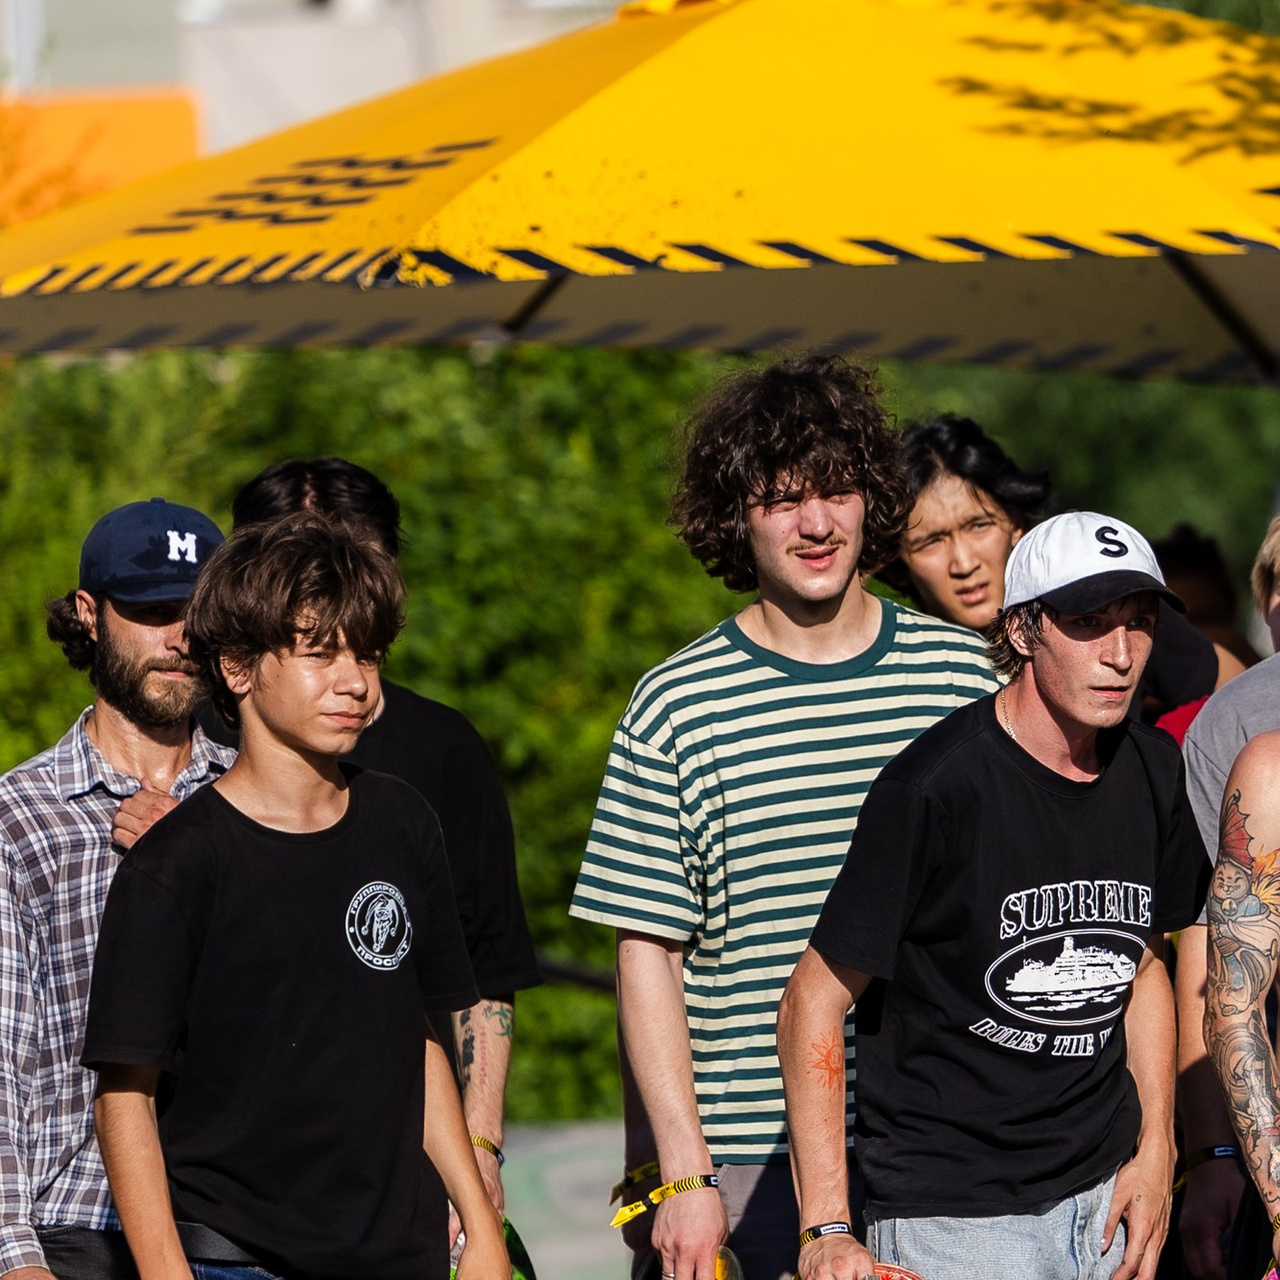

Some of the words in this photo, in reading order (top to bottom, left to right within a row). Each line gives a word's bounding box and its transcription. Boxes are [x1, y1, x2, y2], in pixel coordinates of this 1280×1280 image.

[167, 530, 197, 564] M
[1095, 525, 1129, 558] S
[1000, 880, 1151, 939] SUPREME
[969, 1018, 1046, 1053] RULES
[1052, 1034, 1093, 1056] THE
